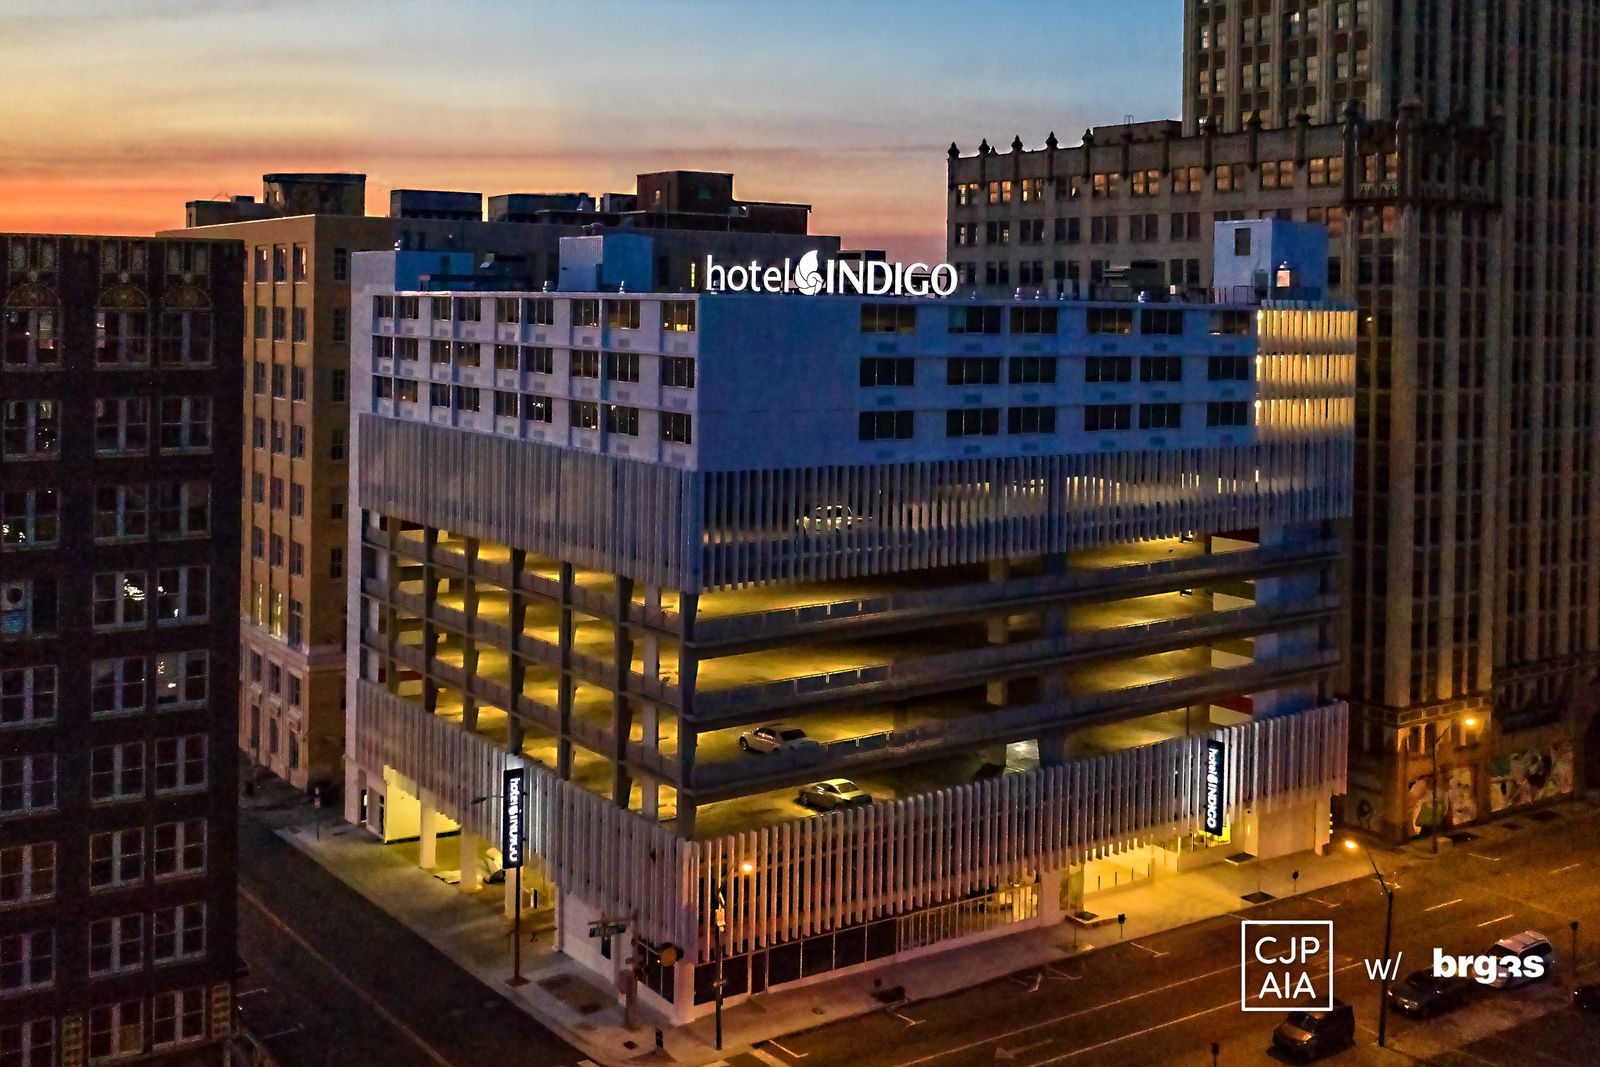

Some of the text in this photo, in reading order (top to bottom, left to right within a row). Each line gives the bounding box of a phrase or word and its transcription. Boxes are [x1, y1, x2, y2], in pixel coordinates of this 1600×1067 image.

[706, 255, 958, 296] hotel INDIGO
[509, 777, 521, 804] hotel
[1206, 748, 1219, 828] hotel INDIGO
